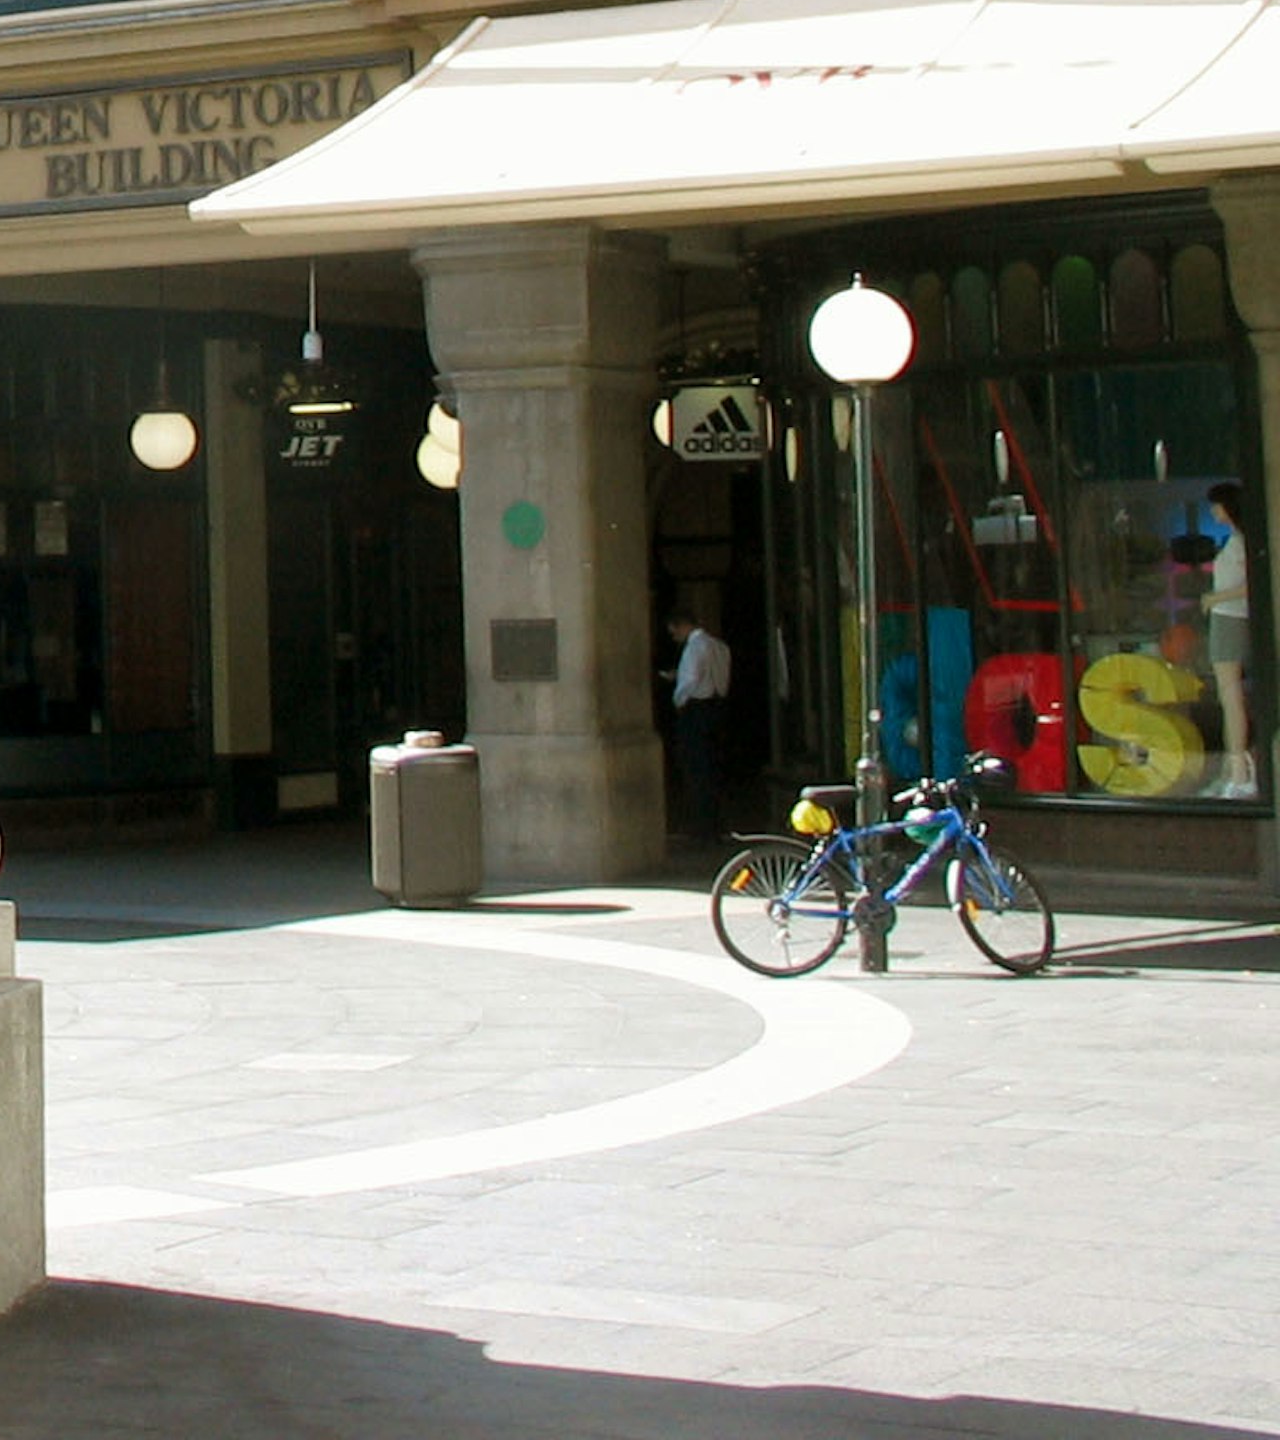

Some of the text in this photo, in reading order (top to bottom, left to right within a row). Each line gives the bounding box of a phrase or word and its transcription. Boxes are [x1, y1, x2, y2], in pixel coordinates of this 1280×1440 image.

[140, 69, 376, 136] VICTORIA
[45, 136, 277, 198] BUILDING
[280, 436, 343, 457] JET
[684, 433, 764, 453] adidas
